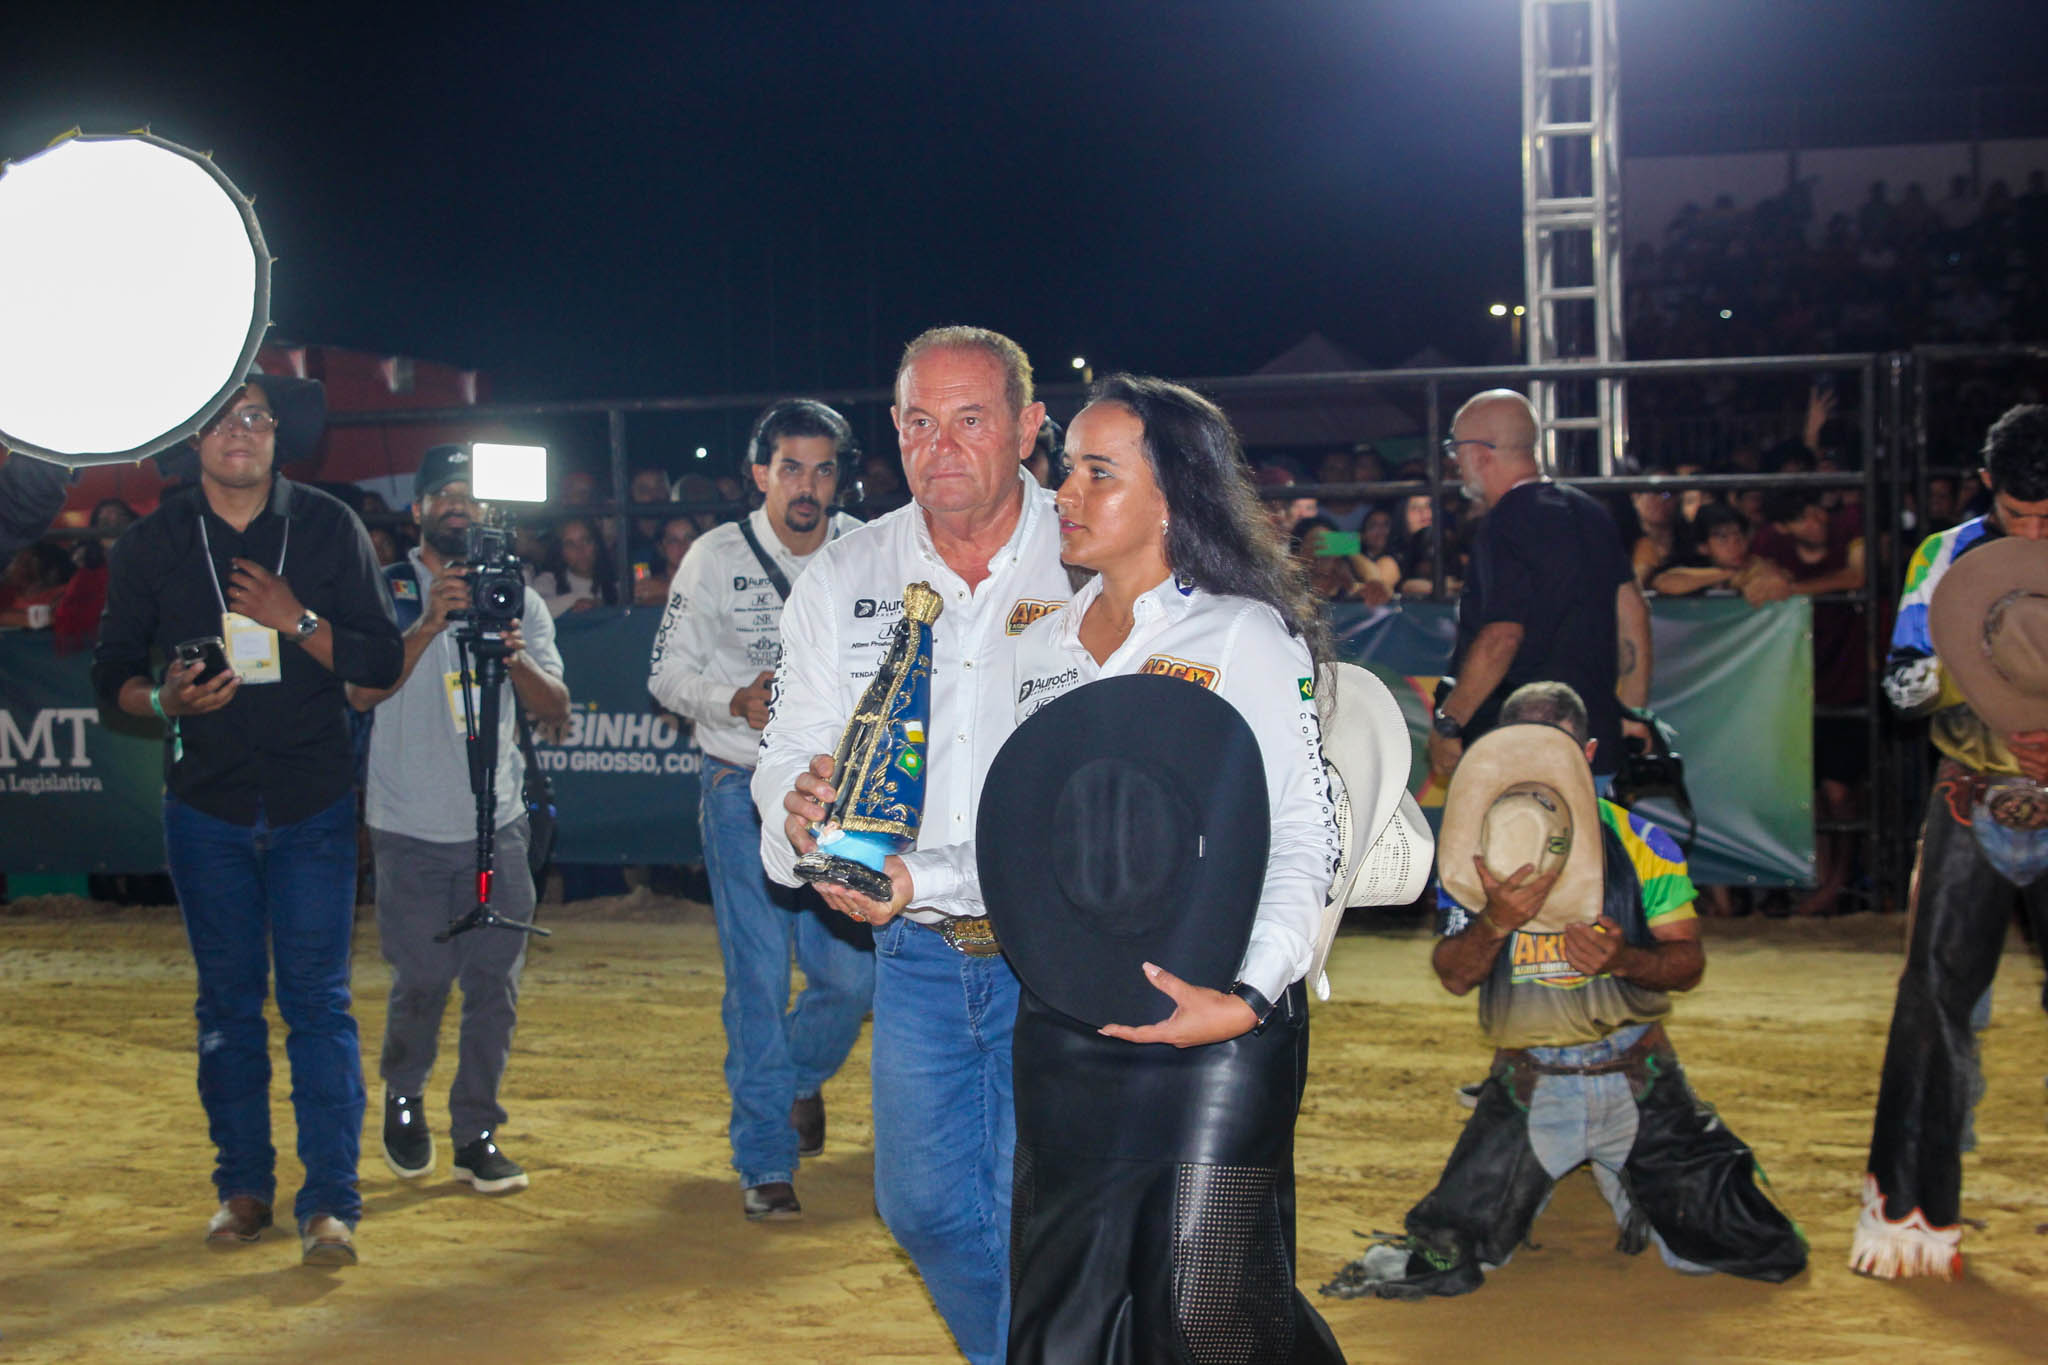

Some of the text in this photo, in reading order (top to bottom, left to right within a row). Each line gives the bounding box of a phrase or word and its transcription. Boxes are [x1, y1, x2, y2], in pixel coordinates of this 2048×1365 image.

[1033, 667, 1079, 692] Aurochs
[531, 713, 679, 748] BINHO
[570, 752, 661, 776] GROSSO,
[1300, 712, 1323, 798] COUNTRY
[9, 773, 103, 794] Legislativa
